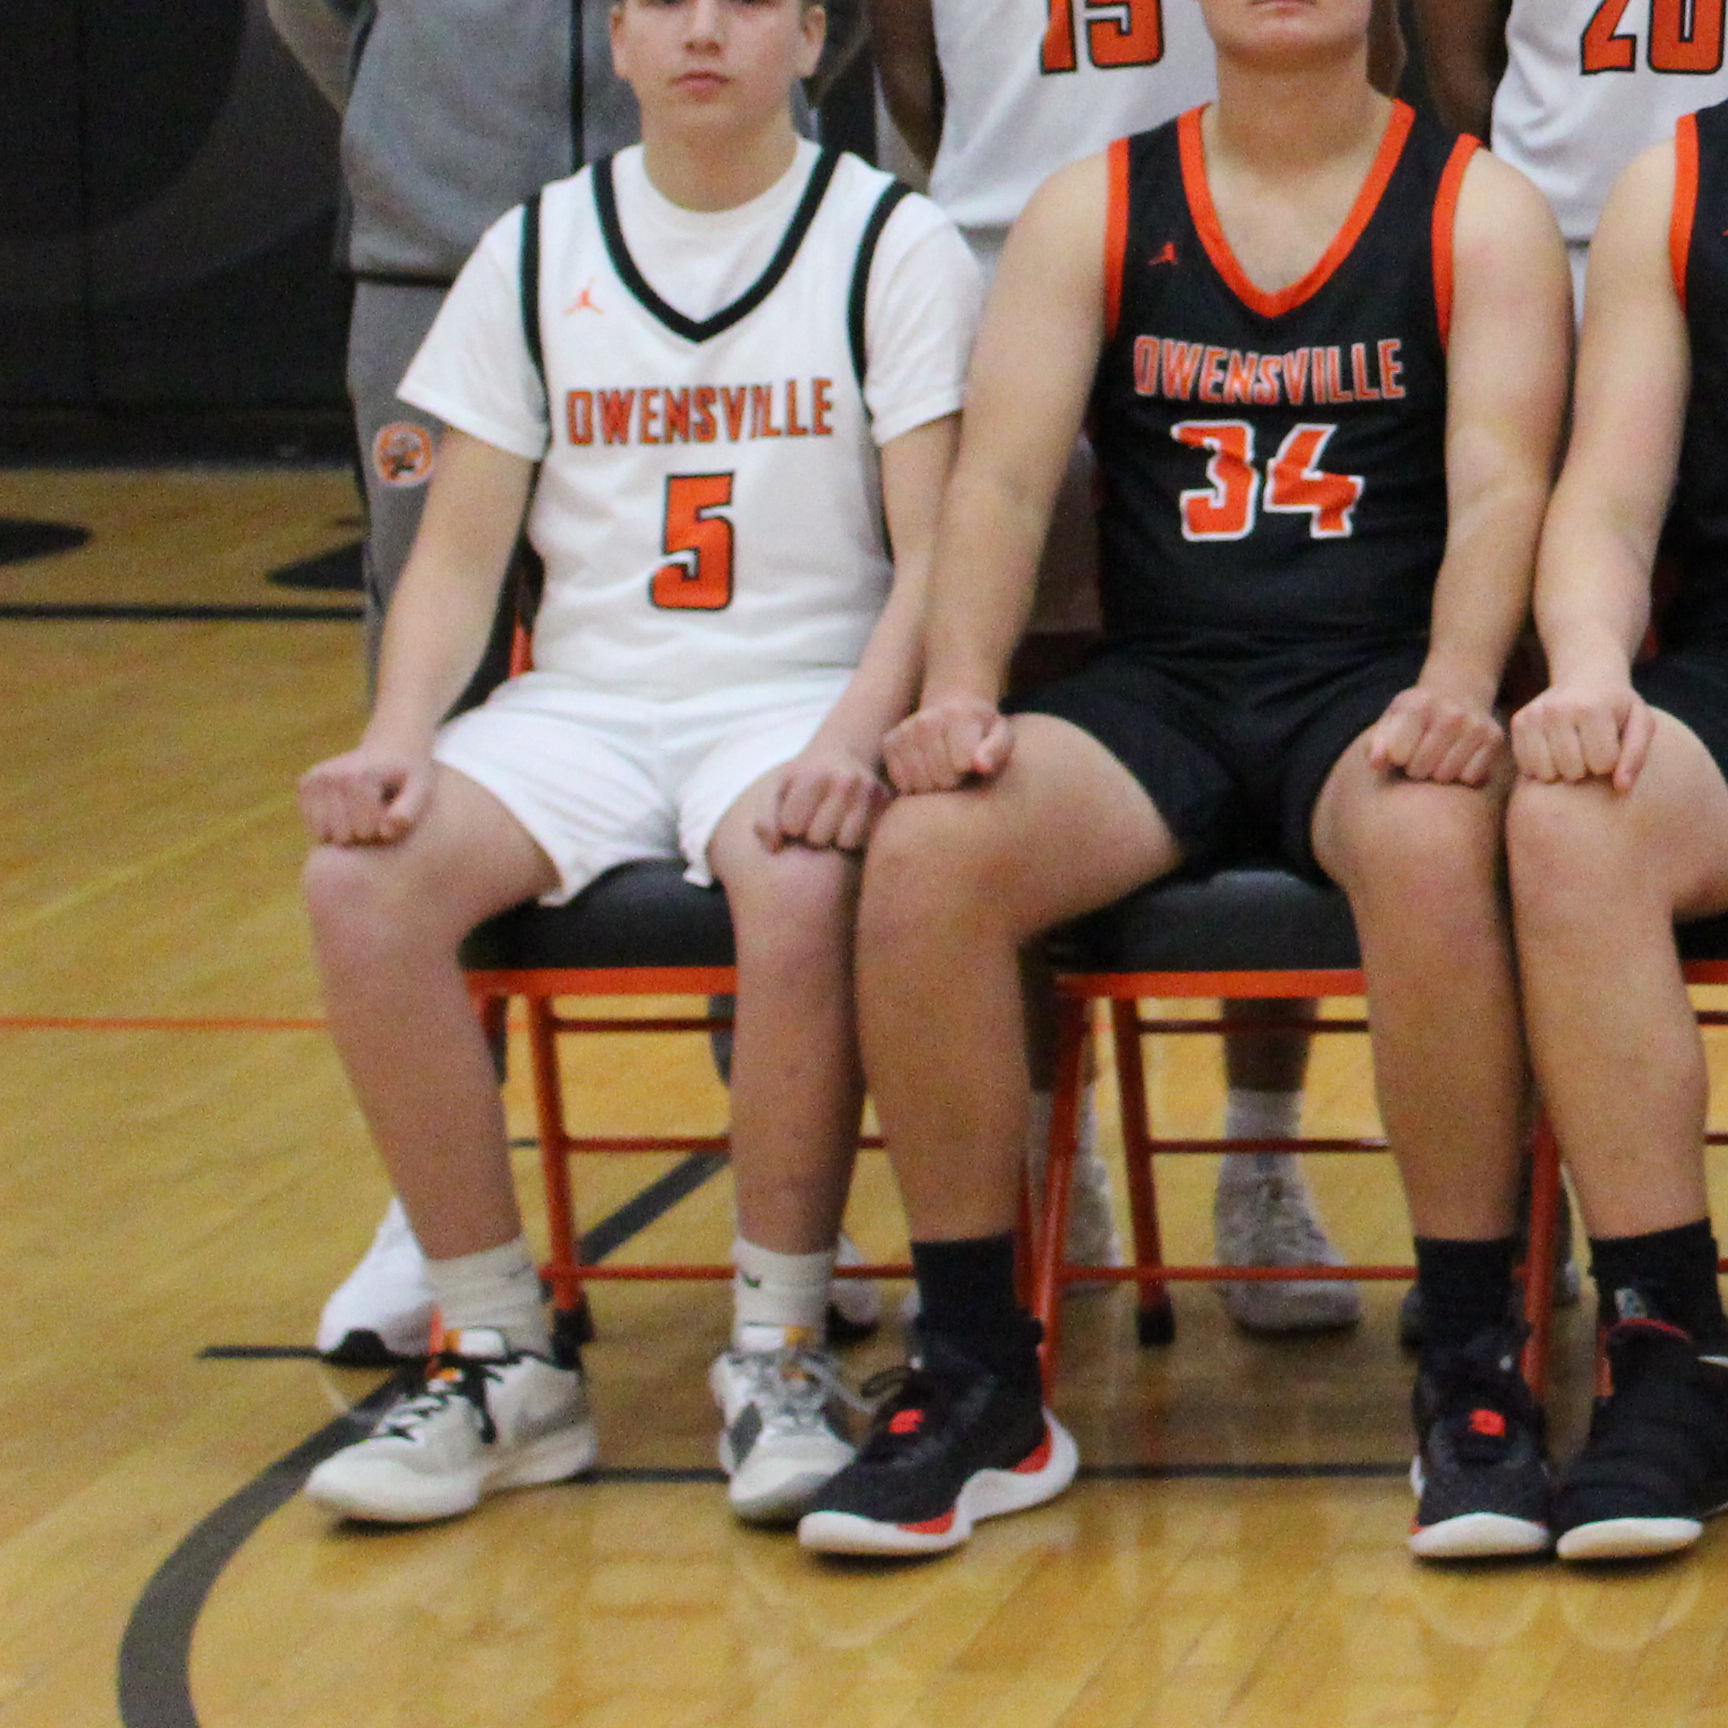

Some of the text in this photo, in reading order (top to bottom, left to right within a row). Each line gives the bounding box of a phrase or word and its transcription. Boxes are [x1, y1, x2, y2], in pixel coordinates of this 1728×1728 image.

[566, 376, 835, 447] OWENSVILLE
[1132, 335, 1406, 406] OWENSVILLE
[1170, 419, 1365, 542] 34
[648, 471, 736, 612] 5
